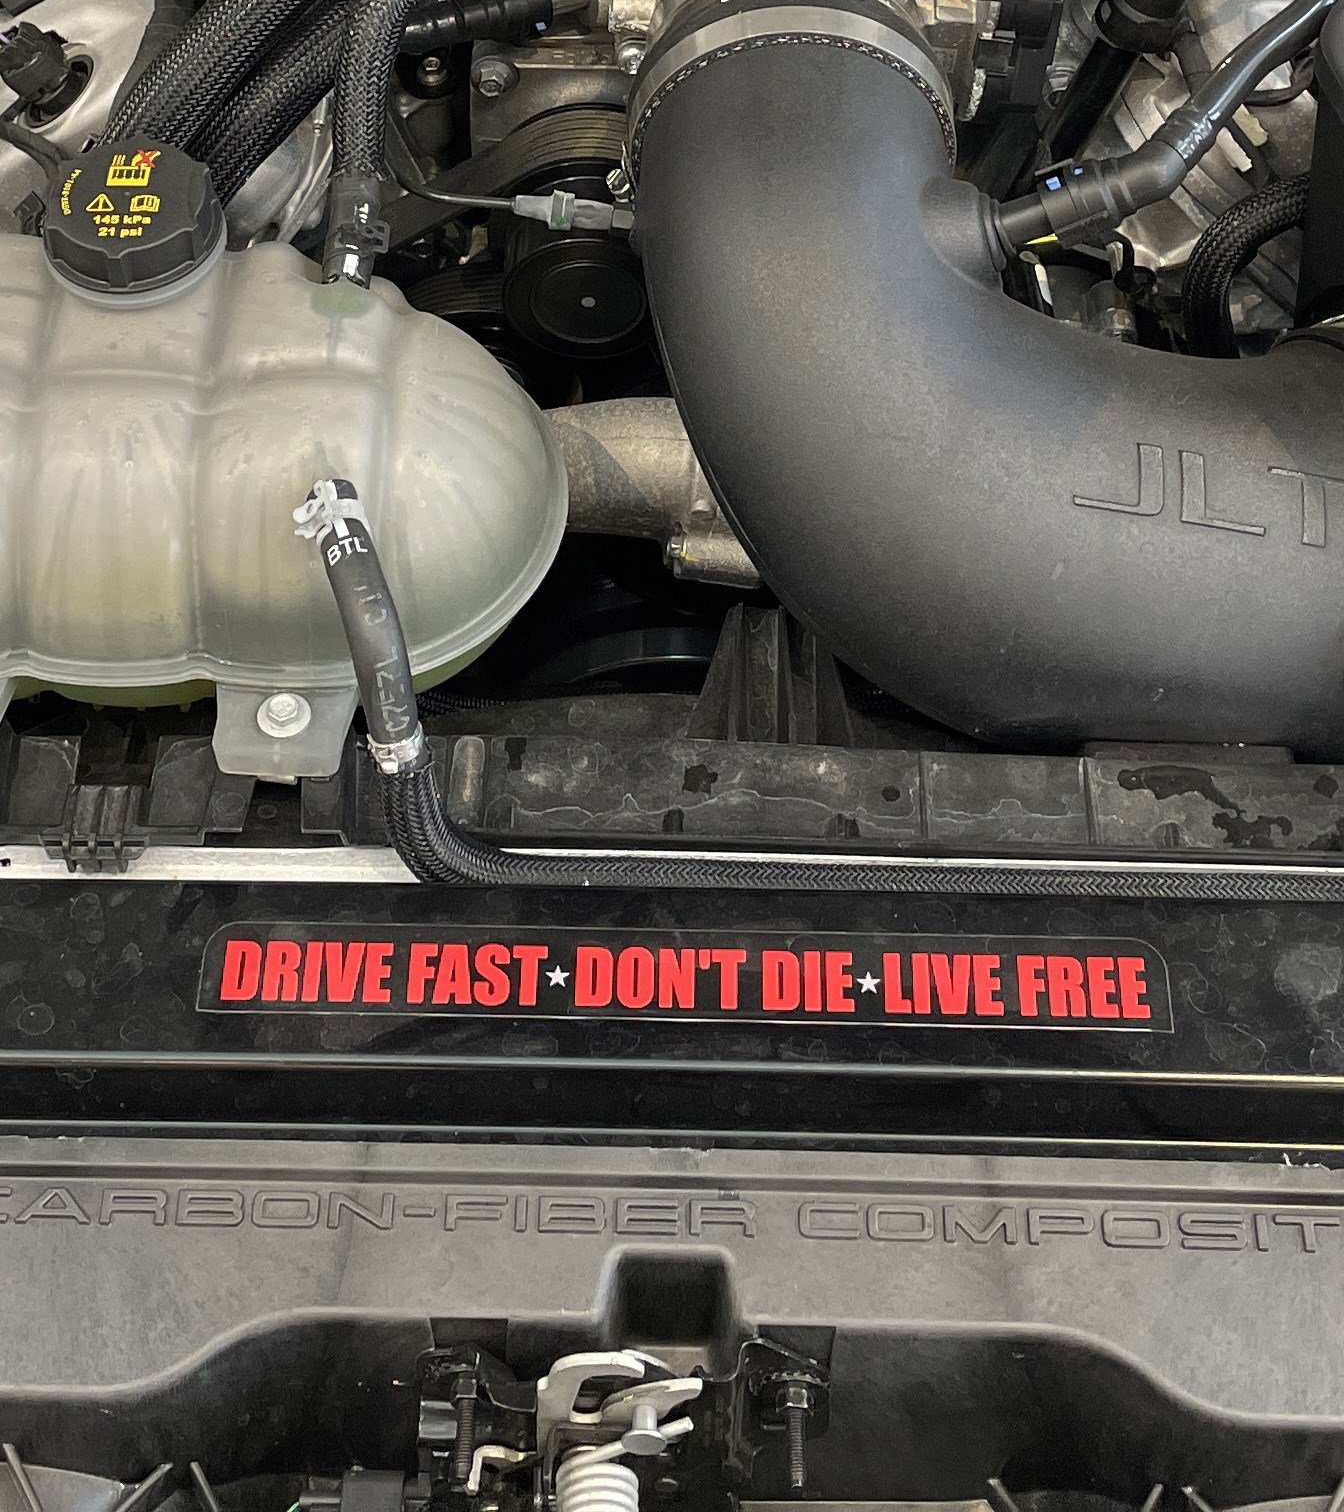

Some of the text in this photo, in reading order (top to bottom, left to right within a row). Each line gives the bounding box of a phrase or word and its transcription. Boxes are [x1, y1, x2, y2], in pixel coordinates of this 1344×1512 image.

[93, 214, 152, 225] 145 kPa
[98, 226, 143, 238] 21 psi
[326, 536, 369, 567] BTL
[220, 939, 1152, 1019] DRIVE FAST DON'T DIE LIVE FREE
